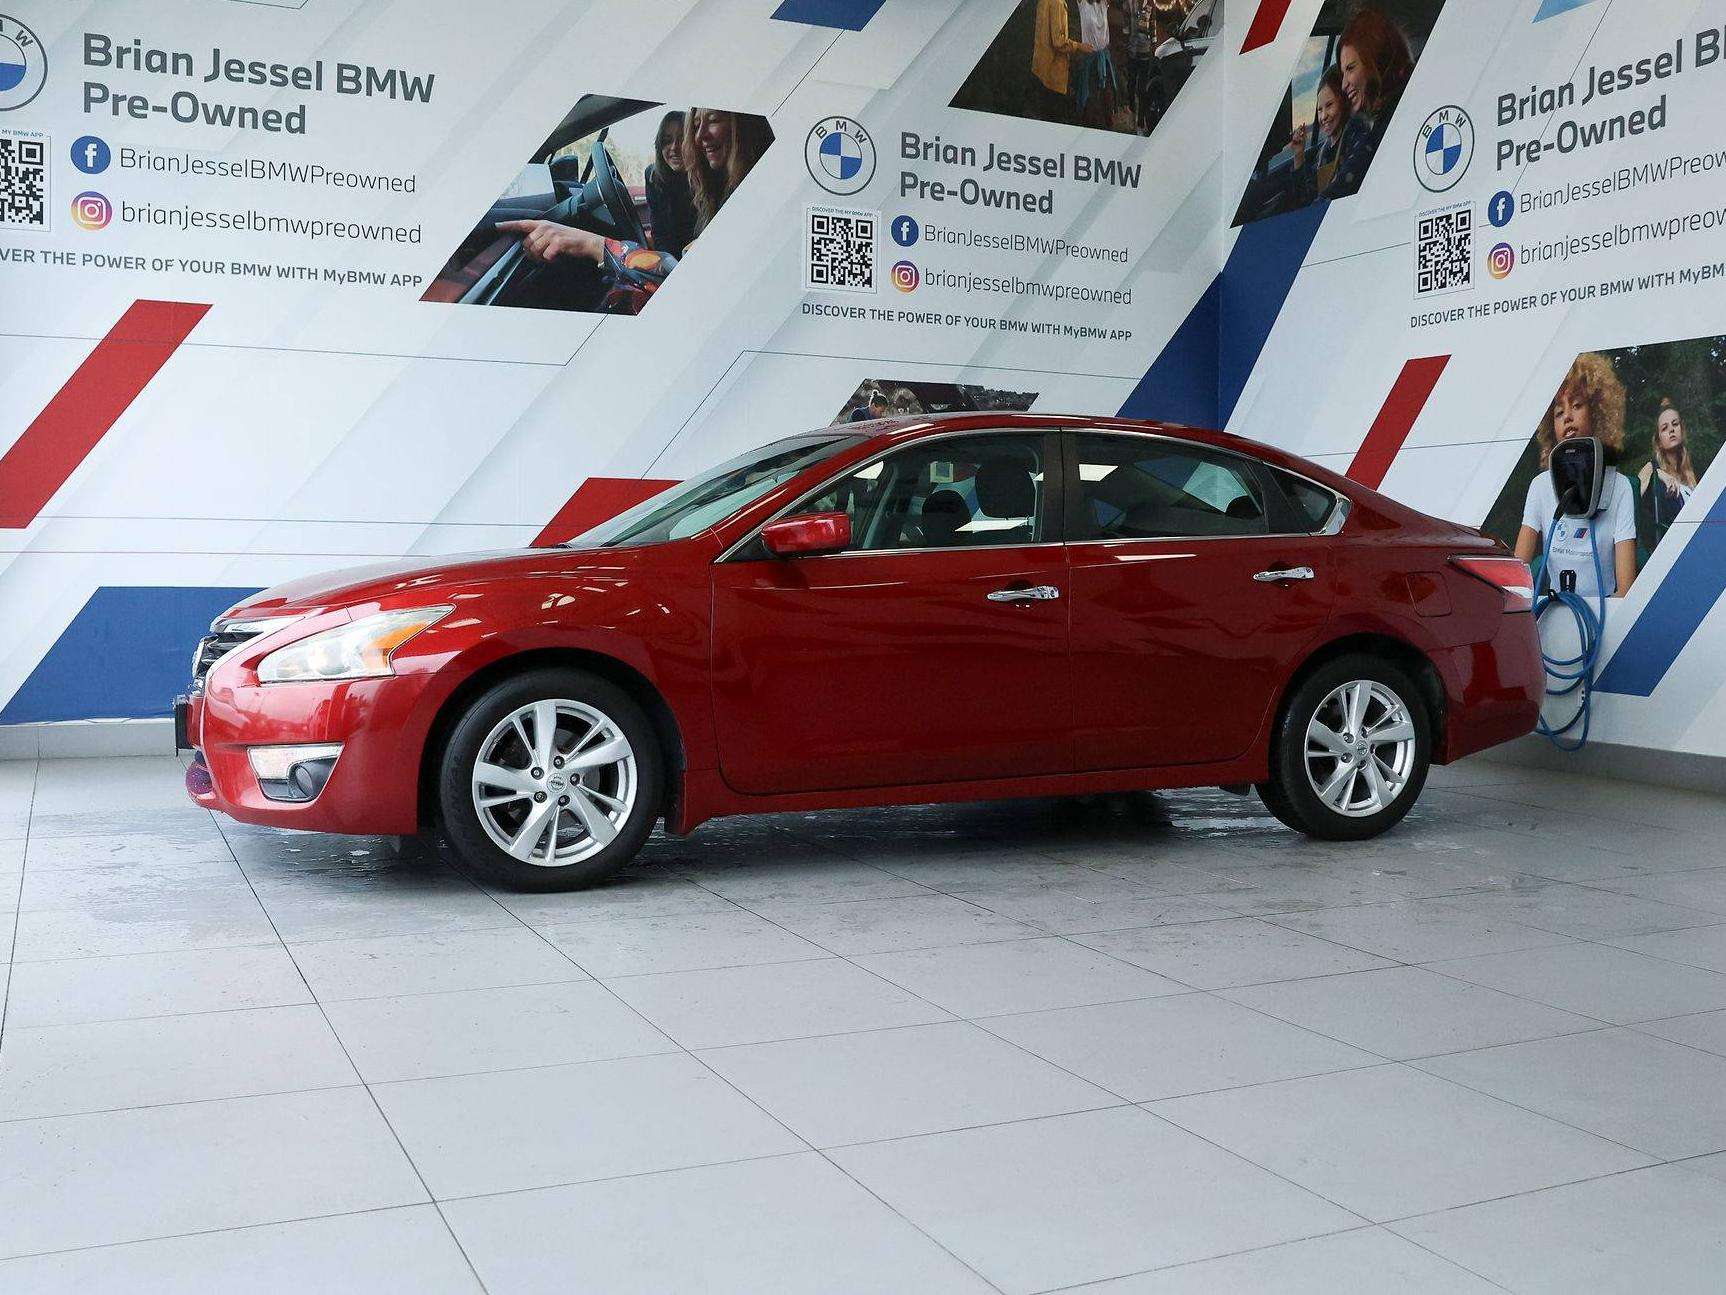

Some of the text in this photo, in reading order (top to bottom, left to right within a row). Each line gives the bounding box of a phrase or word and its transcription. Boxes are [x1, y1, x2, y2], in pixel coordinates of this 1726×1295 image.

[84, 33, 435, 103] Brian Jessel BMW
[1497, 83, 1574, 126] Brian
[1582, 39, 1682, 106] Jessel
[84, 82, 305, 134] Pre-Owned
[1421, 110, 1466, 139] BMW
[815, 120, 868, 144] BMW
[1497, 94, 1666, 171] Pre-Owned
[121, 148, 415, 193] BrianJesselBMWPreowned
[901, 132, 1141, 188] Brian Jessel BMW
[901, 171, 1053, 214] Pre-Owned
[123, 201, 421, 243] brianjesselbmwpreowned
[925, 225, 1128, 262] BrianJesselBMWPreowned
[40, 251, 76, 265] THE
[83, 253, 146, 270] POWER
[152, 258, 174, 271] OF
[178, 259, 225, 274] YOUR
[230, 262, 271, 277] BMW
[276, 266, 318, 280] WITH
[324, 269, 386, 285] MyBMW
[390, 274, 422, 287] APP
[926, 268, 1131, 304] brianjesselbmwpreowned
[1411, 308, 1464, 328] DISCOVER
[1467, 304, 1490, 318] THE
[1494, 296, 1537, 314] POWER
[1541, 292, 1557, 306] OF
[1560, 285, 1596, 302] YOUR
[1600, 278, 1634, 296] BMW
[1638, 272, 1674, 290] WITH
[802, 303, 1132, 341] DISCOVER THE POWER OF YOUR BMW WITH MyBMW APP
